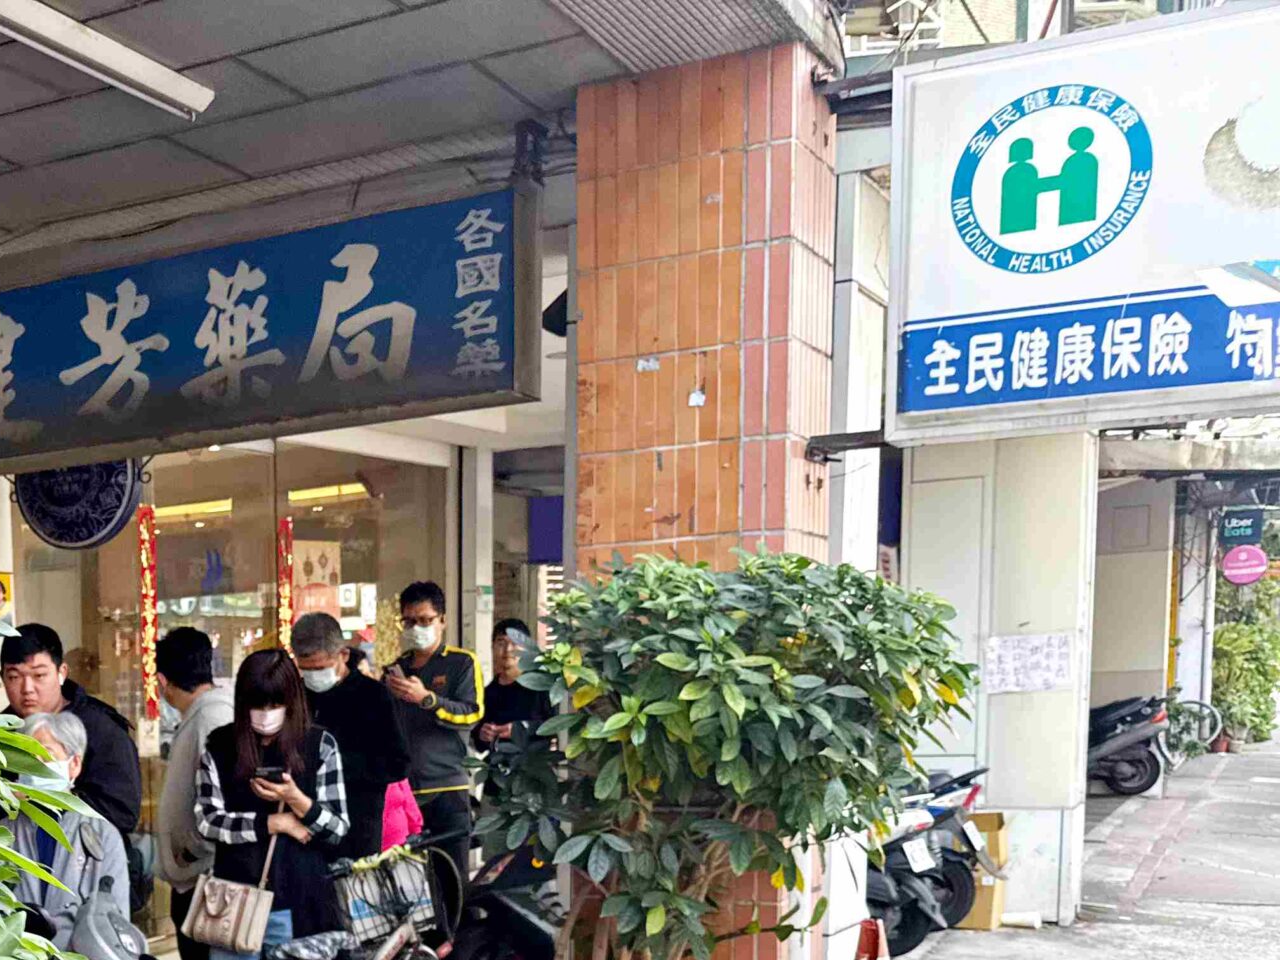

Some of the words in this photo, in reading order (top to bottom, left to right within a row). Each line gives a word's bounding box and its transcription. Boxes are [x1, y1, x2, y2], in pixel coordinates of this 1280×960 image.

[969, 85, 1140, 158] 全民健康保險
[952, 196, 998, 264] NATIONAL
[1007, 249, 1074, 273] HEALTH
[1081, 169, 1151, 255] INSURANCE
[923, 311, 1193, 397] 全民健康保險
[1224, 517, 1254, 528] Uber
